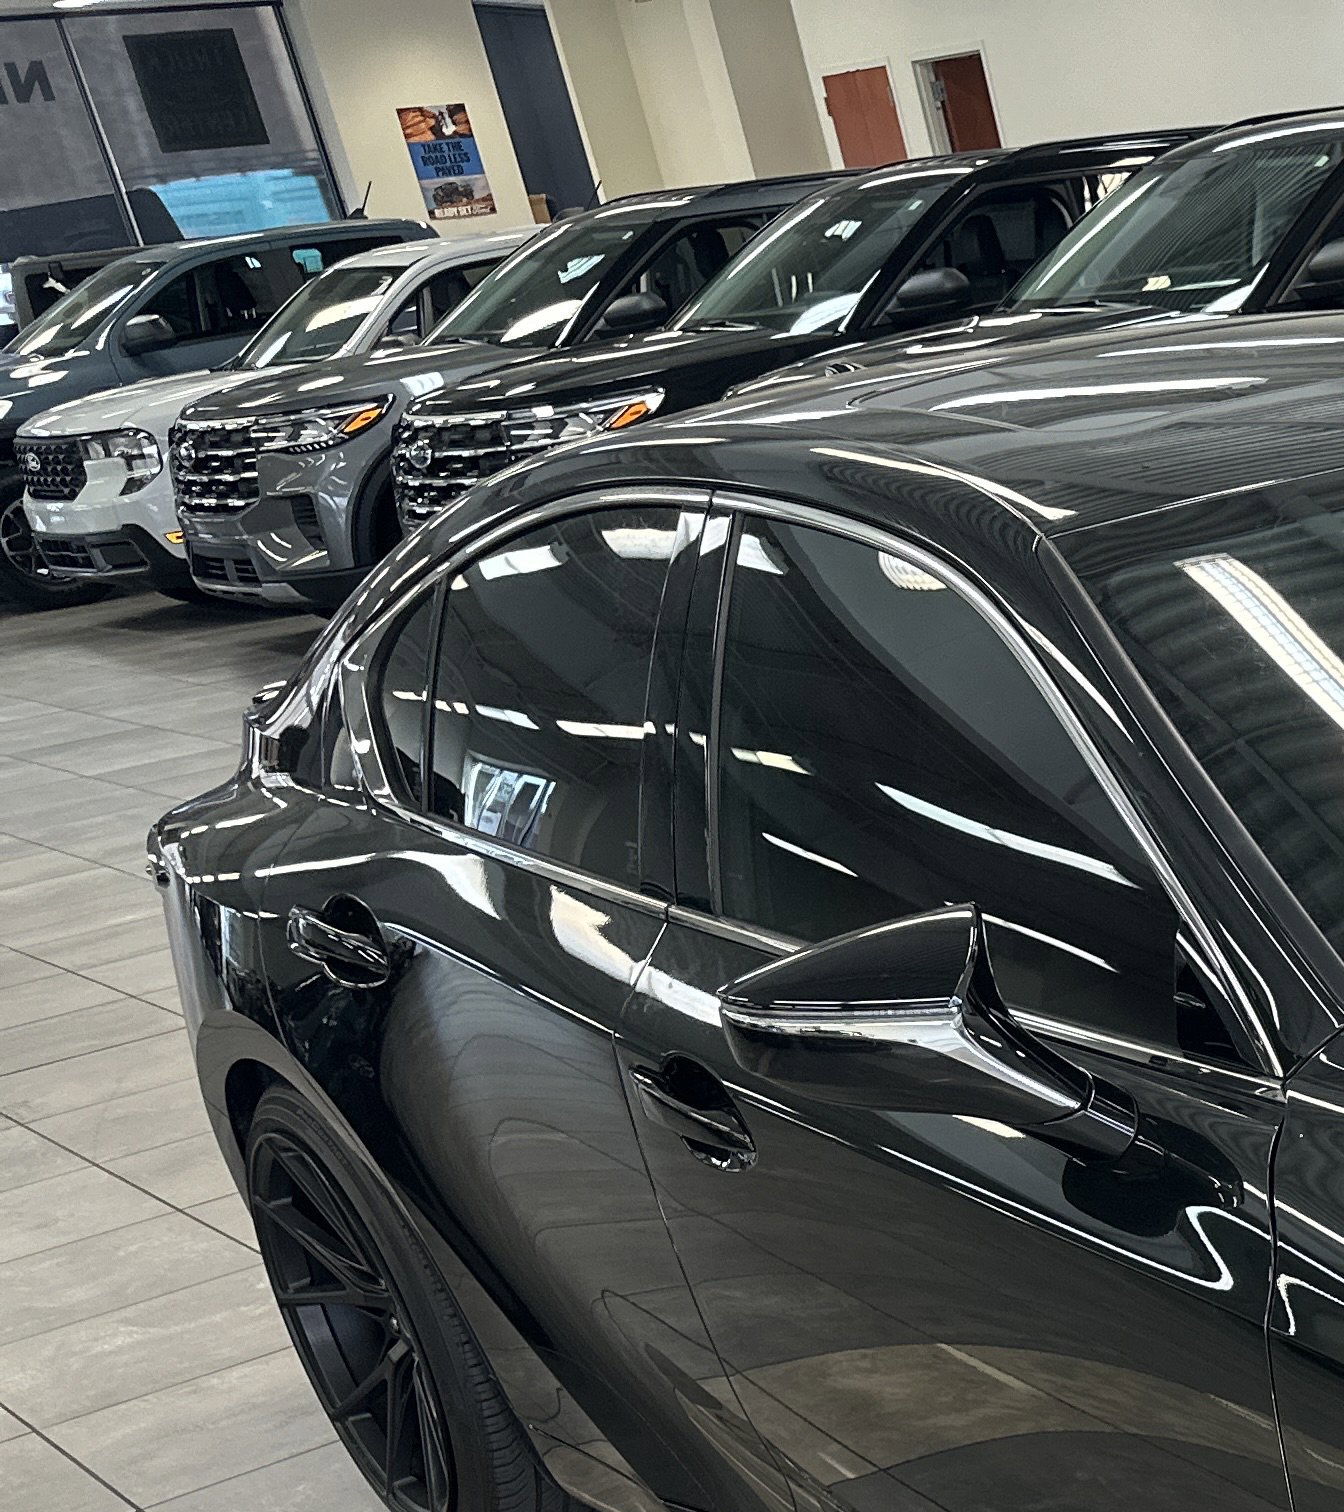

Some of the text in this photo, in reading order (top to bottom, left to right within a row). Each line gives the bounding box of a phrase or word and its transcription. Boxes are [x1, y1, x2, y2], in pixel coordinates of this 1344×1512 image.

[421, 140, 465, 154] TAKE THE
[421, 152, 471, 167] ROAD LESS
[434, 165, 465, 177] PAVED
